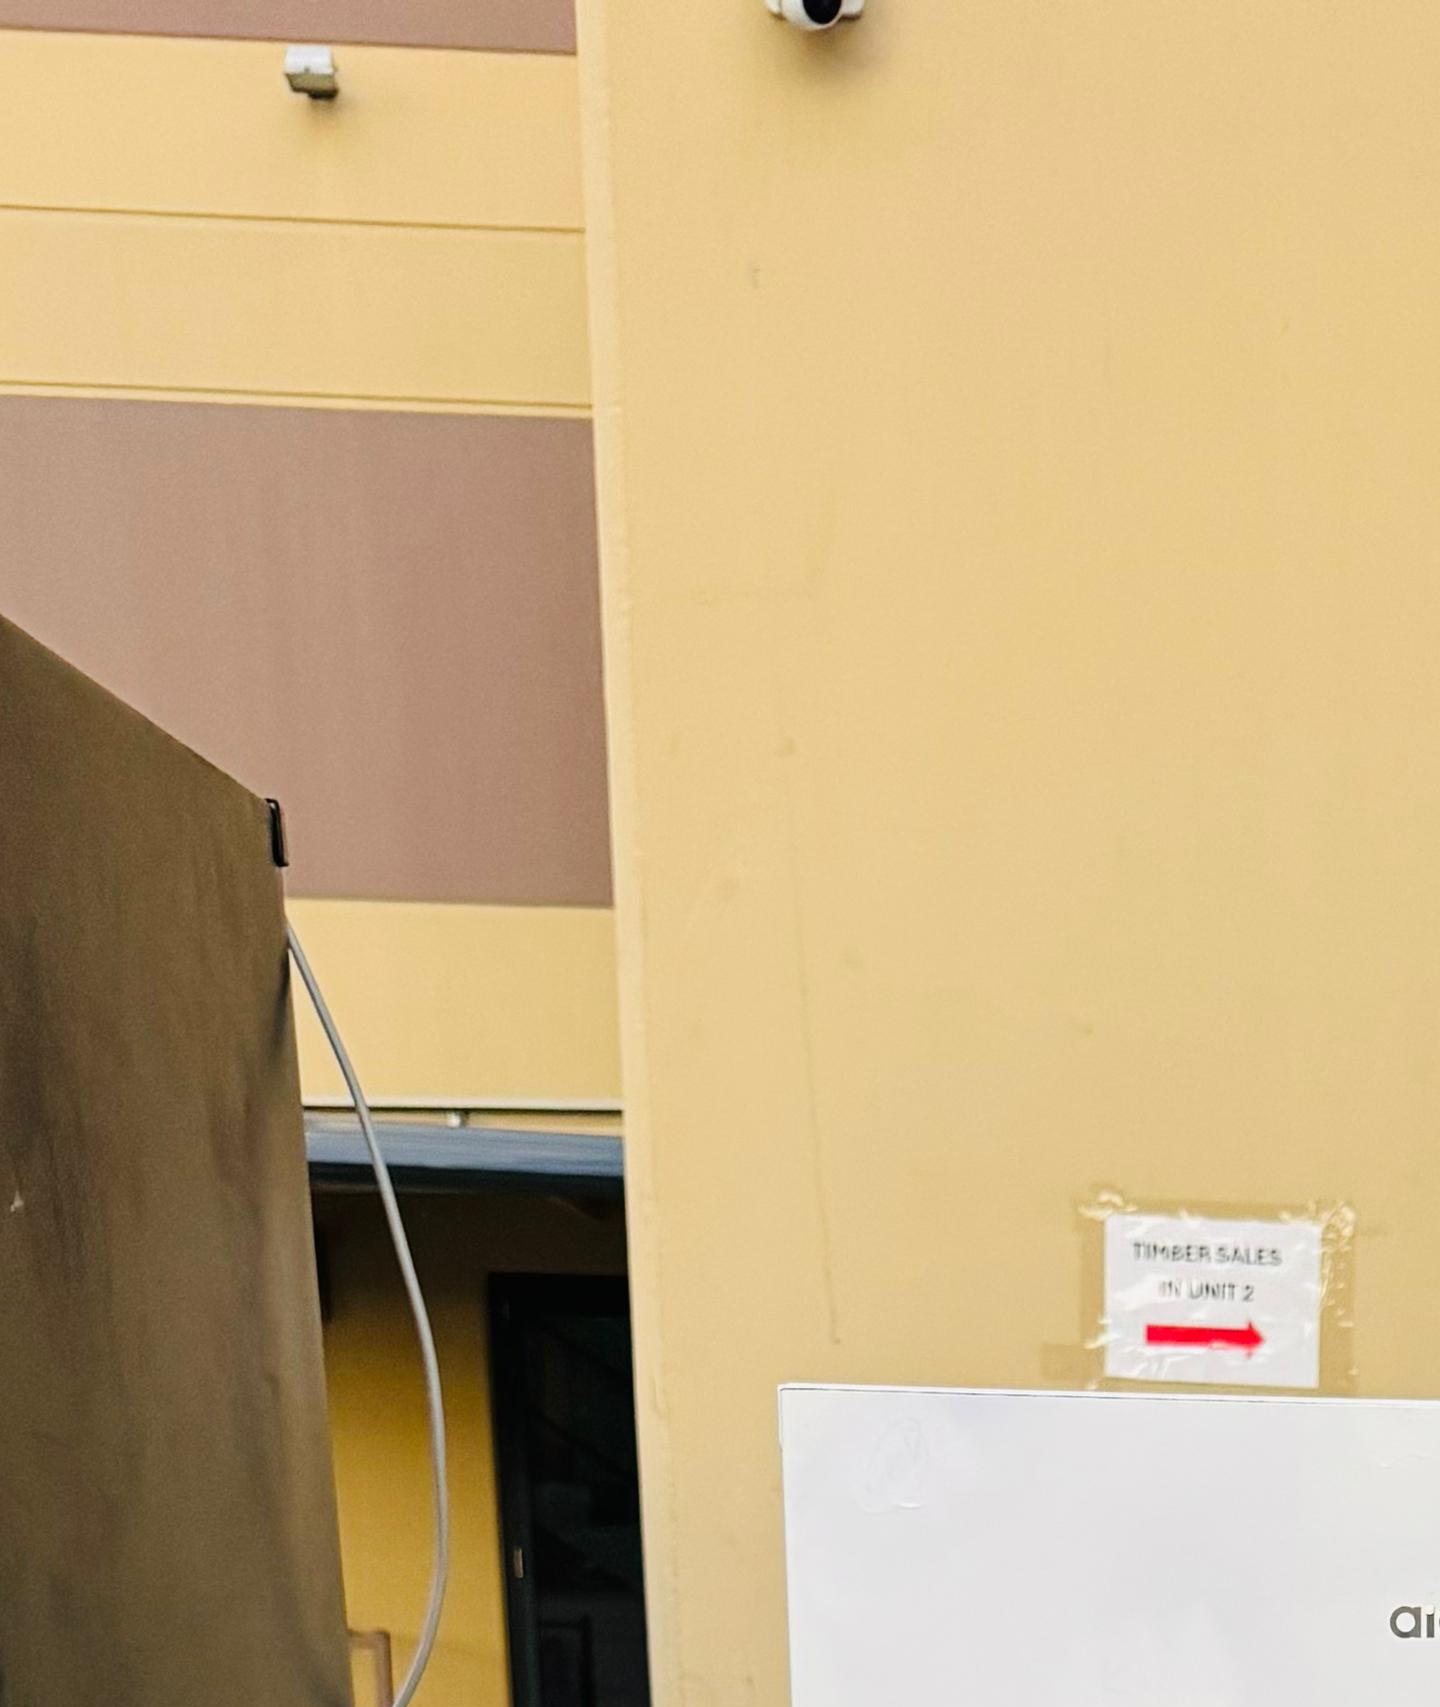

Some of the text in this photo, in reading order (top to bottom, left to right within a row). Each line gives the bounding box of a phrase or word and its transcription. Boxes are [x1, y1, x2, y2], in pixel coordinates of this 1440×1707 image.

[1133, 1243, 1283, 1266] TIMBER SALES
[1159, 1280, 1254, 1302] IN UNIT 2
